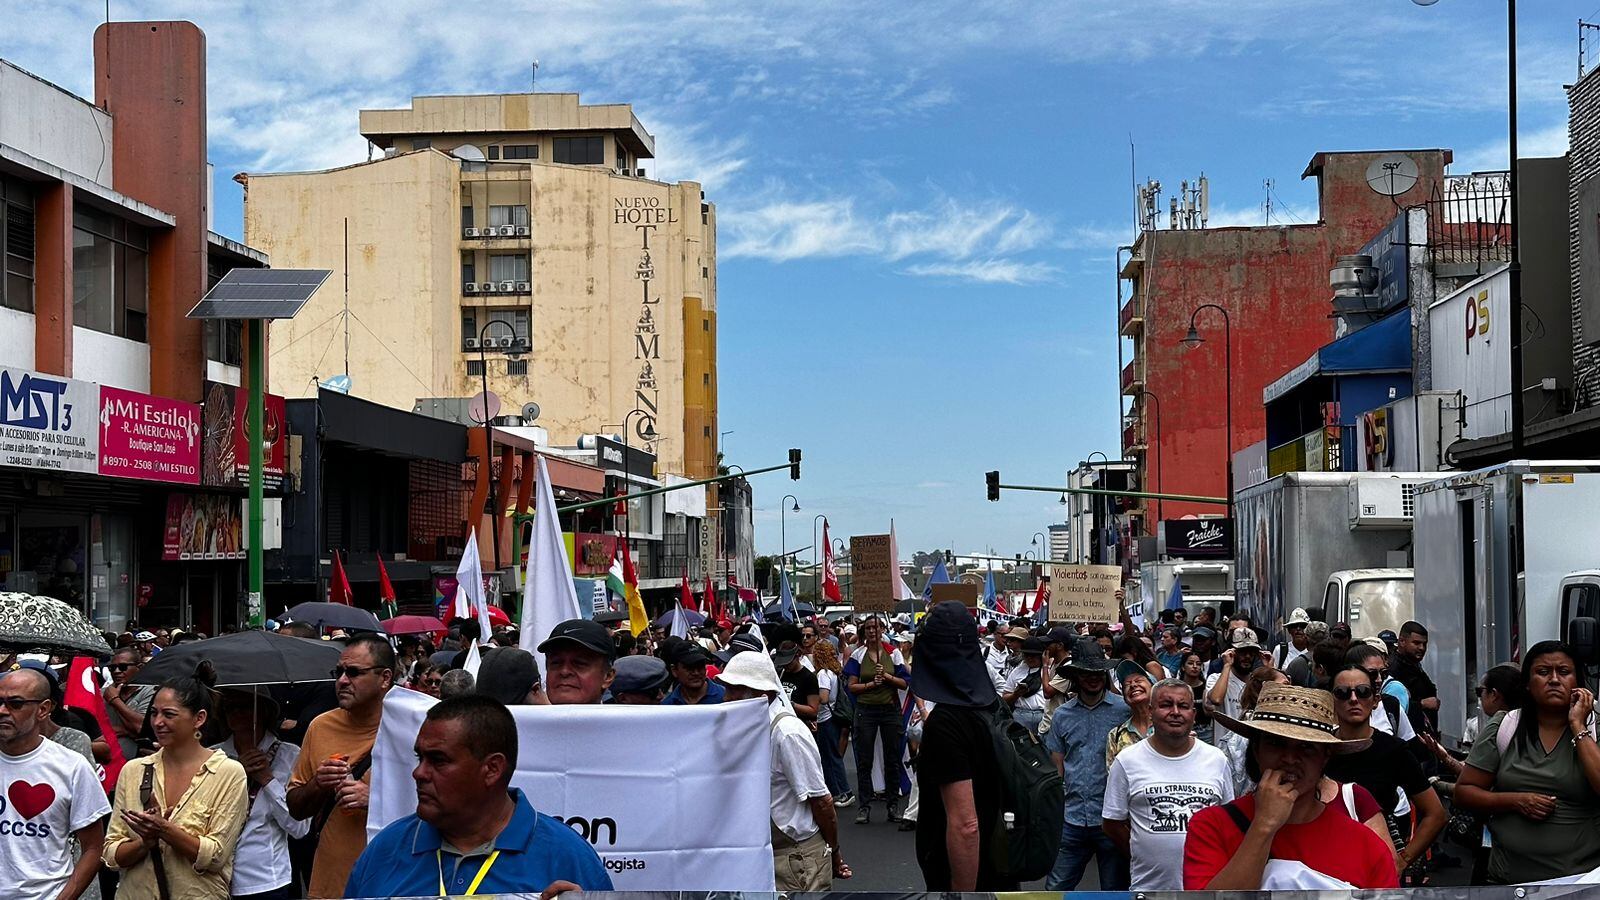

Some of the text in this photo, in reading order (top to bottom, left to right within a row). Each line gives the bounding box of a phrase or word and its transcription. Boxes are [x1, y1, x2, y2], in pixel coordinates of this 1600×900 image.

[615, 197, 659, 208] NUEVO
[614, 208, 678, 223] HOTEL
[116, 399, 187, 428] Mi Estilo
[5, 428, 40, 441] ACCESORIOS
[41, 433, 56, 443] PARA
[56, 434, 63, 444] SU
[64, 436, 86, 447] CELULAR
[153, 440, 164, 452] San
[164, 443, 176, 454] José
[109, 456, 128, 467] 8970
[134, 459, 152, 470] 2508
[160, 463, 195, 475] MI ESTILO
[1146, 786, 1162, 794] LEVI
[1165, 785, 1197, 794] STRAUSS
[553, 816, 616, 845] on
